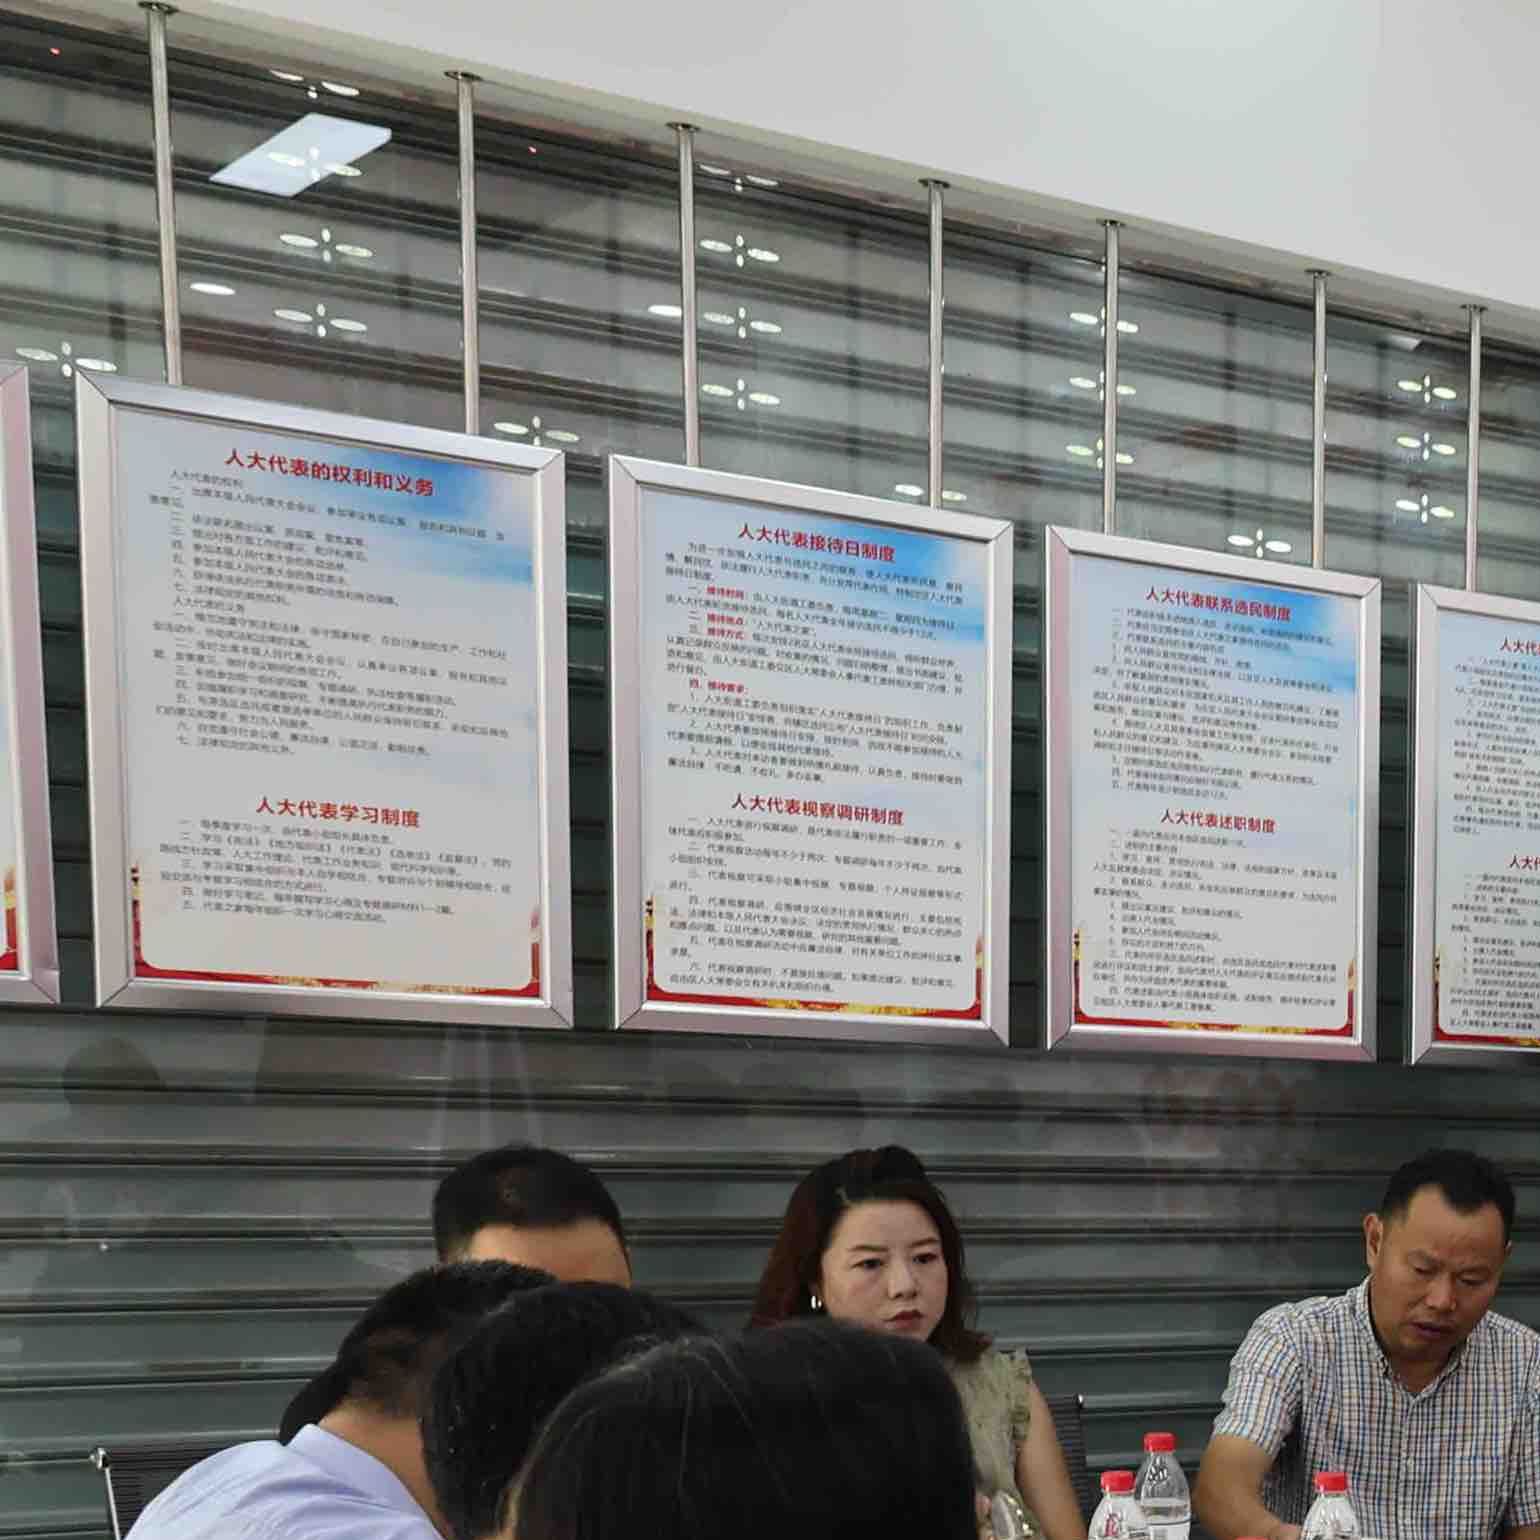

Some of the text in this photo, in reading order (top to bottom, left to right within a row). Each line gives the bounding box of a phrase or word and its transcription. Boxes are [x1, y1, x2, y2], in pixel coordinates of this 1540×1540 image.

[224, 448, 435, 498] 人大代表的权利和义务
[738, 522, 896, 564] 人大代表接待日制度
[1145, 585, 1291, 622] 人大代表联系选民制度
[256, 796, 421, 828] 人大代表学习制度
[731, 792, 904, 827] 人大代表视察调研制度
[1160, 808, 1276, 834] 人大代表述职制度
